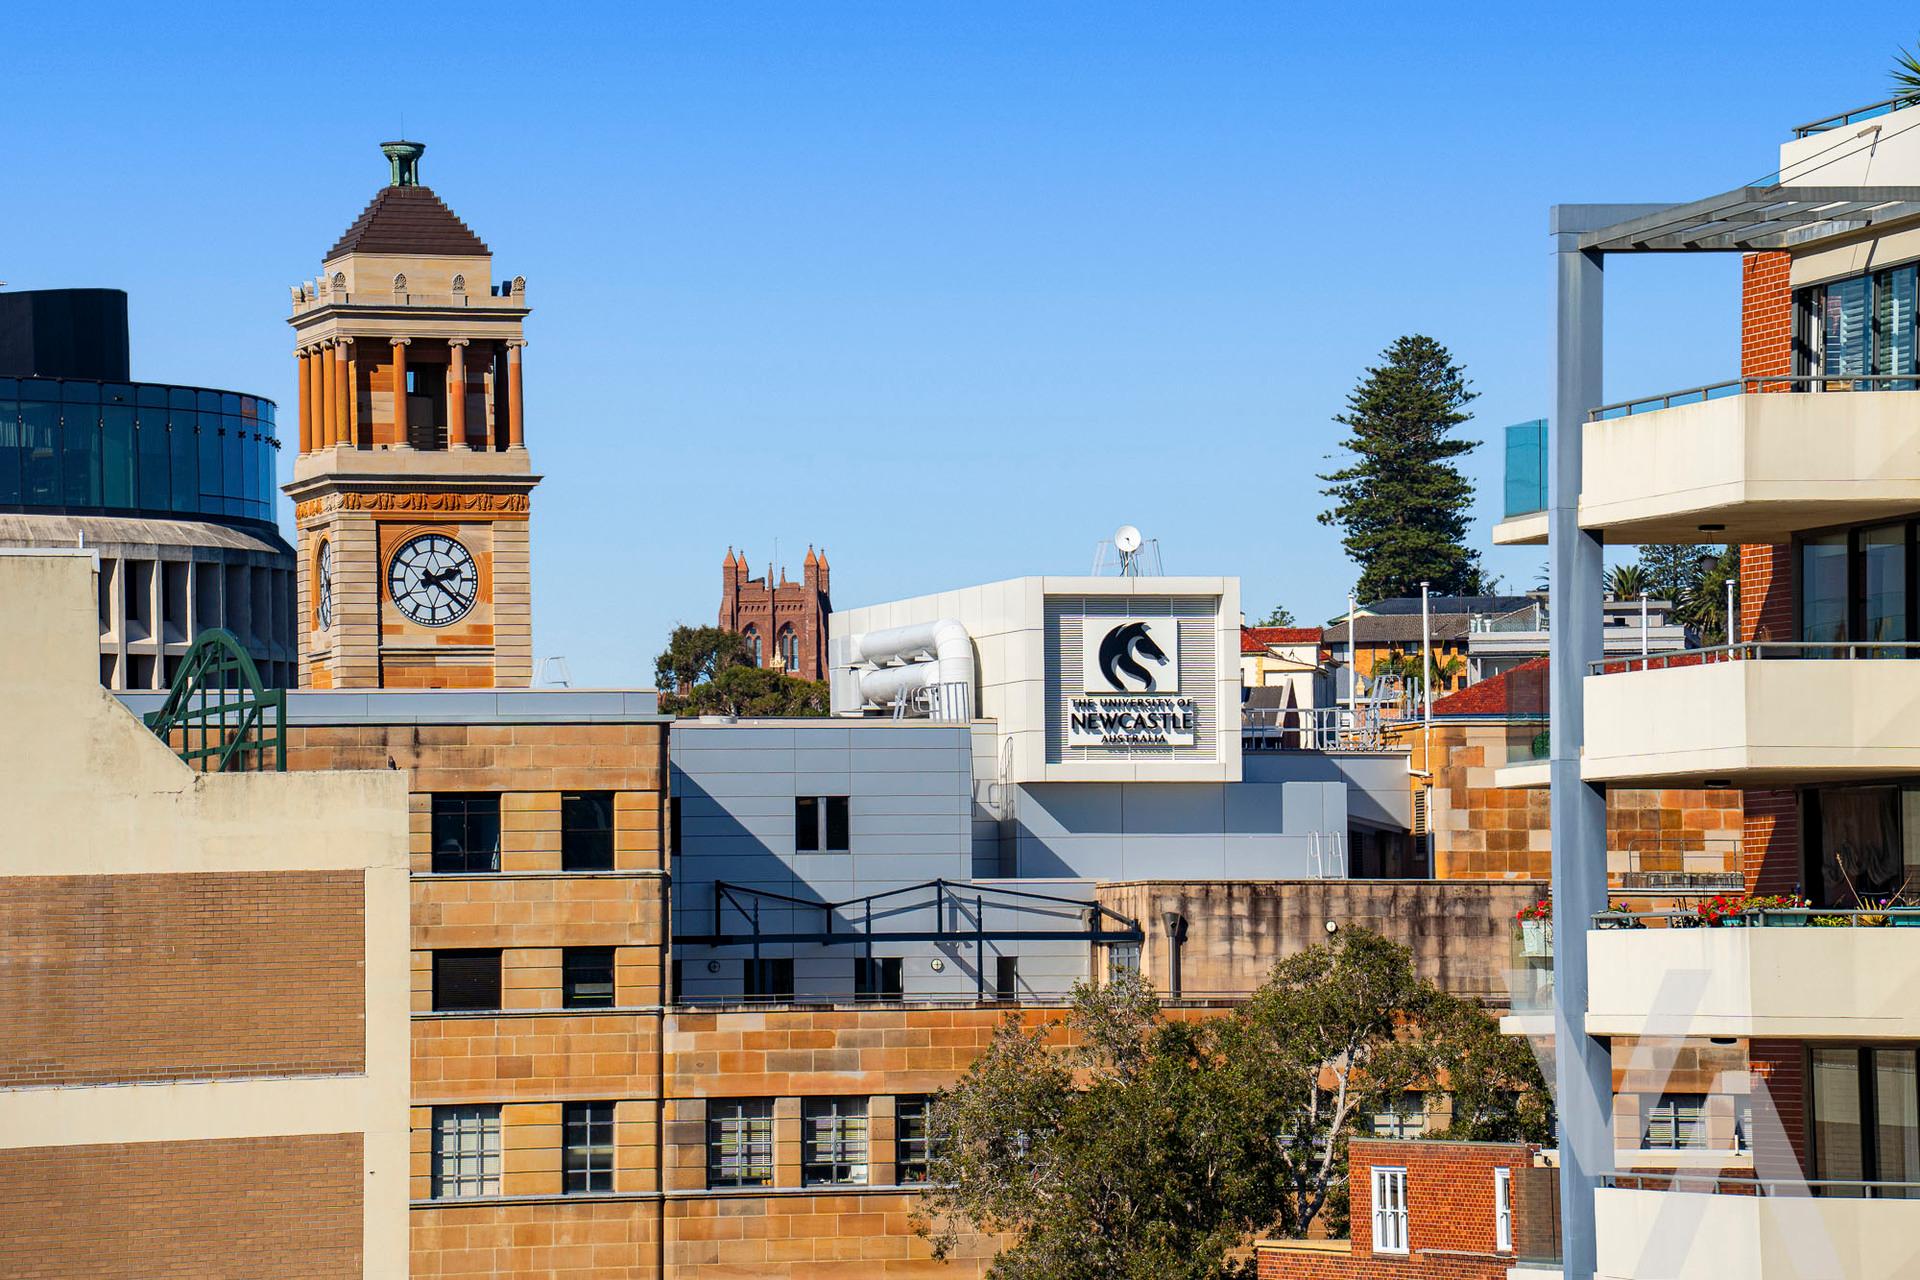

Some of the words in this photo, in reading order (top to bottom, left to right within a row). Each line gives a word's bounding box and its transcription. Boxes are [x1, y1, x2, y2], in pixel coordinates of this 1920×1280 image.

[1071, 698, 1094, 707] THE
[1100, 698, 1171, 707] UNIVERSITY
[1177, 698, 1192, 707] OF
[1071, 713, 1193, 729] NEWCASTLE
[1101, 734, 1166, 743] AUSTRALIA
